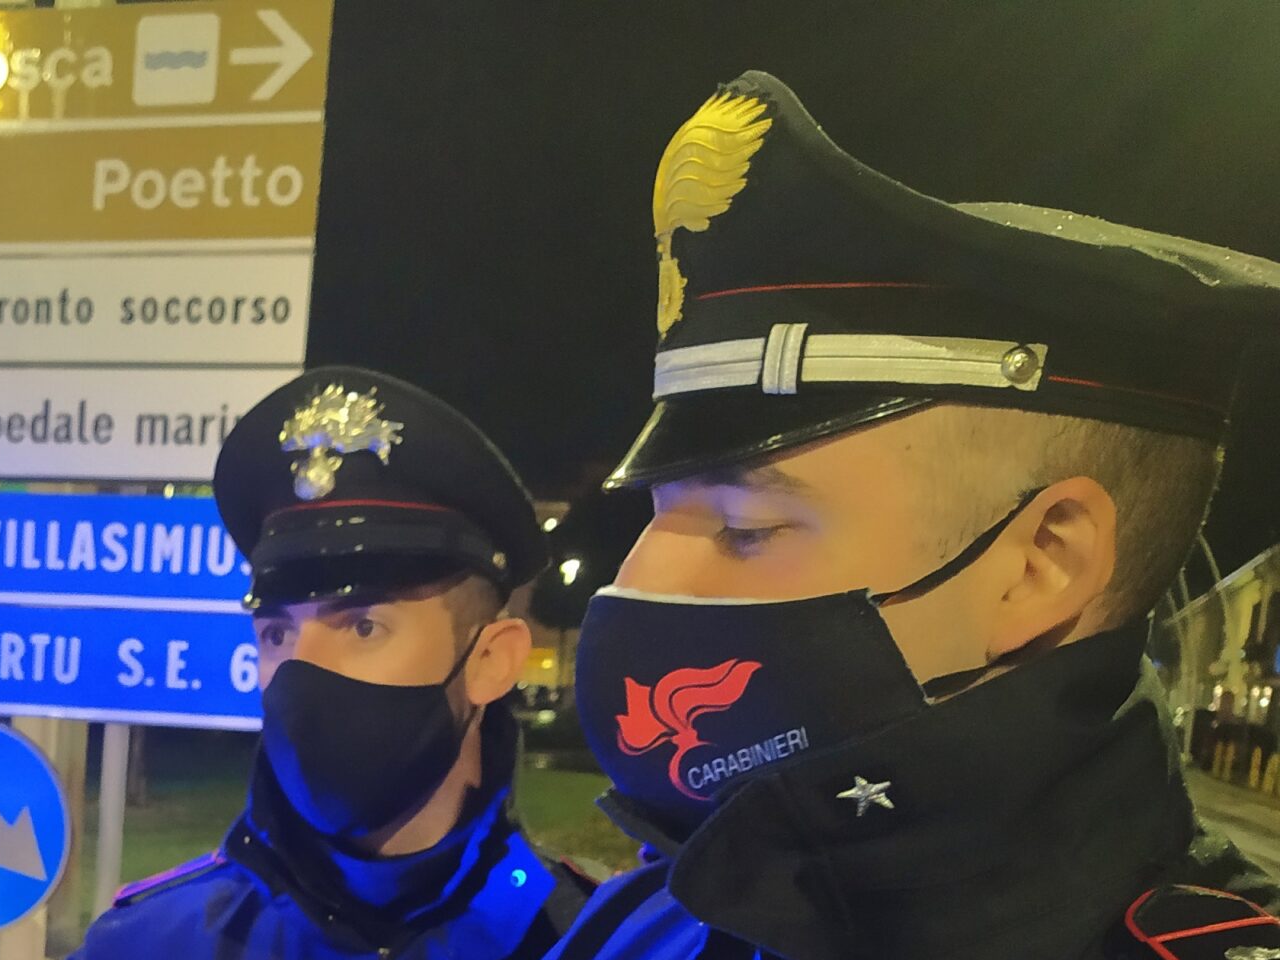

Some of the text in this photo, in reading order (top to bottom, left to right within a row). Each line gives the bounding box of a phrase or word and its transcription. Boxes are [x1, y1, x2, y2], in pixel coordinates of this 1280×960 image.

[92, 154, 304, 210] Poetto
[119, 292, 292, 325] soccorso
[135, 402, 244, 446] mari
[687, 727, 809, 789] CARABINIERI
